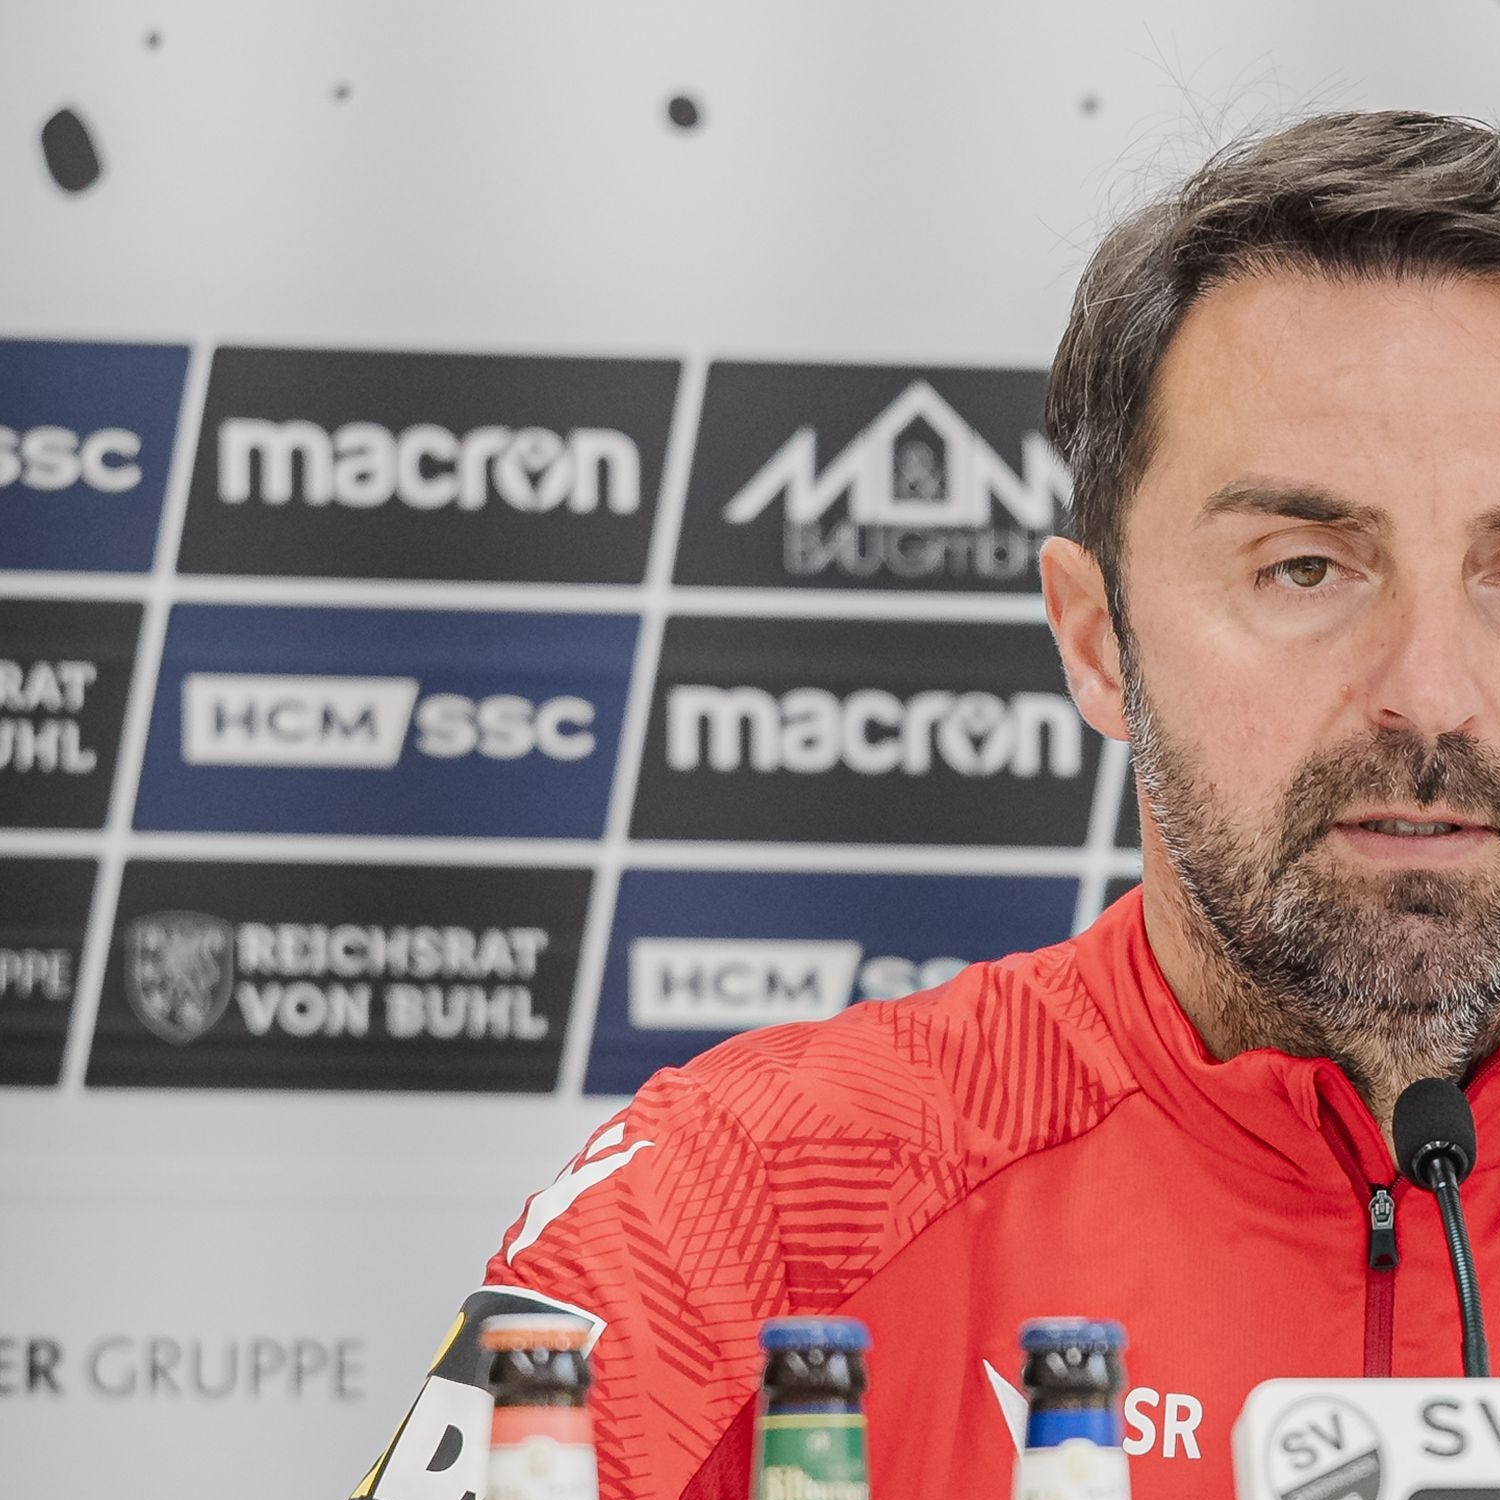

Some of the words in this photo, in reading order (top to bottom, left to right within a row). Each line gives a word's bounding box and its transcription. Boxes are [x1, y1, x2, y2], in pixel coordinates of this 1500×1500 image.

[218, 415, 641, 515] macron
[213, 700, 381, 744] HCM
[415, 693, 596, 762] SSC
[666, 684, 1083, 778] macron
[236, 922, 549, 979] REICHSRAT
[658, 958, 824, 1002] HCM
[238, 983, 371, 1038] VON
[384, 983, 549, 1041] BUHL
[82, 1335, 367, 1402] GRUPPE
[1122, 1387, 1202, 1460] SR
[1281, 1410, 1345, 1470] SV
